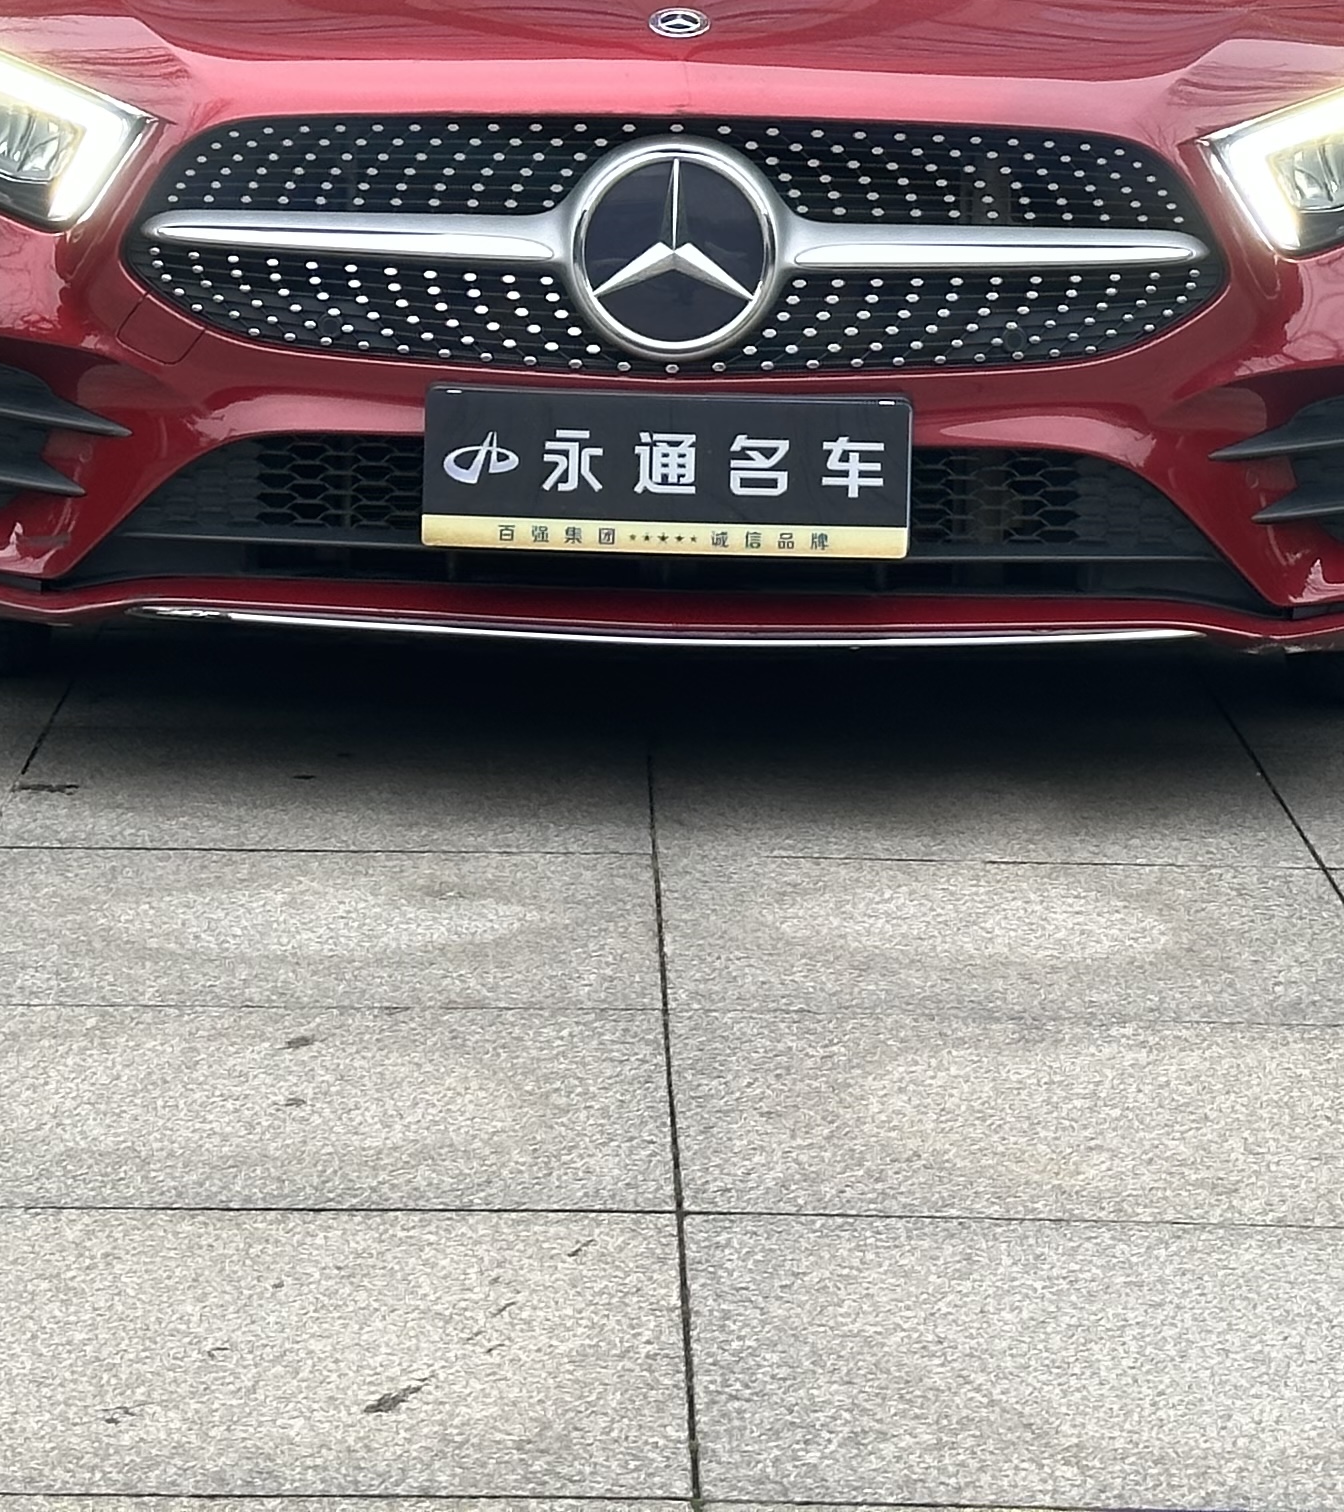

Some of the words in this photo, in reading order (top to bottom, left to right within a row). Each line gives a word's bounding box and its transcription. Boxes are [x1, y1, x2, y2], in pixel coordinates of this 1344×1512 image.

[542, 429, 885, 498] 永通名车
[497, 524, 616, 545] 百强集团
[711, 531, 829, 551] 诚信品牌
